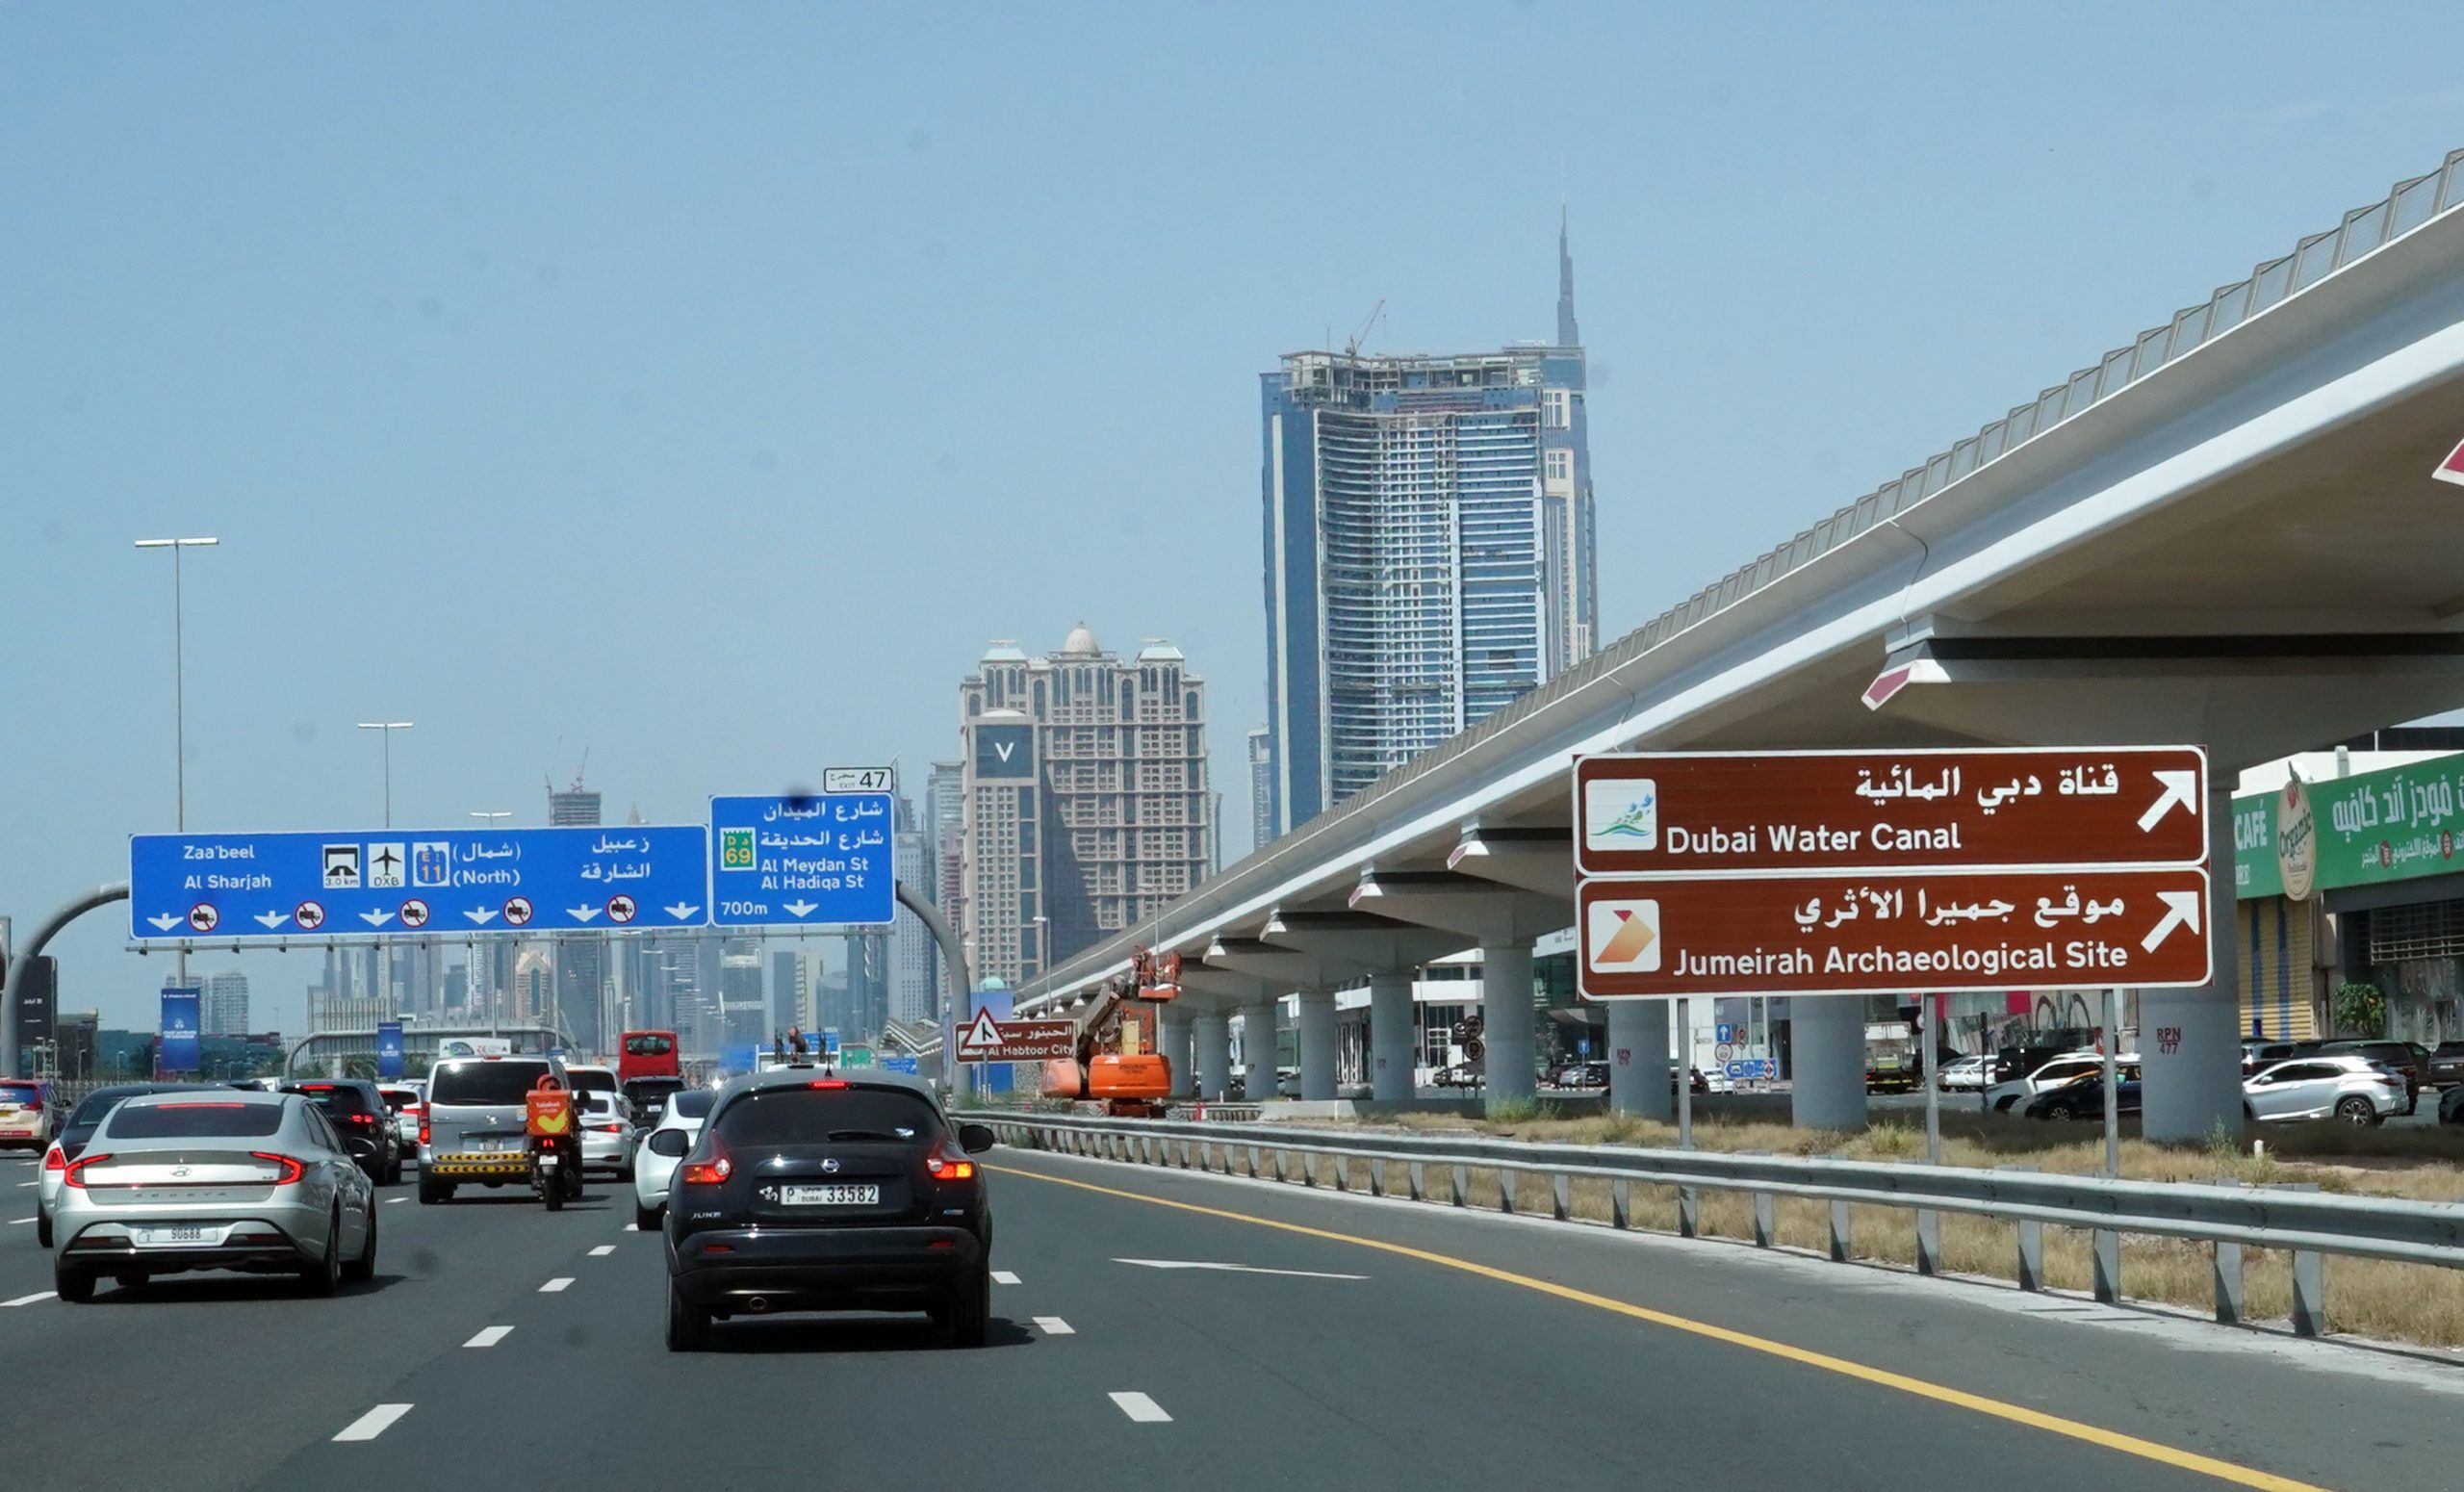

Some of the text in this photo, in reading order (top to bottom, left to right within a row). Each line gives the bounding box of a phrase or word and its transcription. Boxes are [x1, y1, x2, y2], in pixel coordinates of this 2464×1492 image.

[994, 742, 1014, 762] V
[860, 771, 886, 788] 47
[1855, 763, 2118, 814] قناة دبي المائية
[2410, 774, 2453, 828] فودز
[763, 802, 884, 822] شارع الميدان
[2332, 785, 2378, 843] كافيه
[591, 835, 650, 855] زعبيل
[760, 831, 884, 851] شارع الحديقة
[1666, 822, 1962, 855] Dubai Water Canal
[184, 845, 255, 861] Zaa'beel
[726, 848, 751, 863] 69
[422, 864, 441, 881] 11
[580, 863, 651, 884] الشارقة
[761, 858, 869, 874] Al Meydan St
[184, 874, 271, 890] Al Sharjah
[373, 877, 399, 887] DXB
[761, 874, 864, 891] Al Hadiqa St
[720, 901, 768, 915] 700m
[1794, 886, 2124, 933] موقع جميرا الأثري
[1673, 941, 2129, 977] Jumeirah Archaeological Site
[988, 1043, 1073, 1056] Al Habtoor City
[786, 1187, 794, 1202] P
[827, 1186, 877, 1202] 33582
